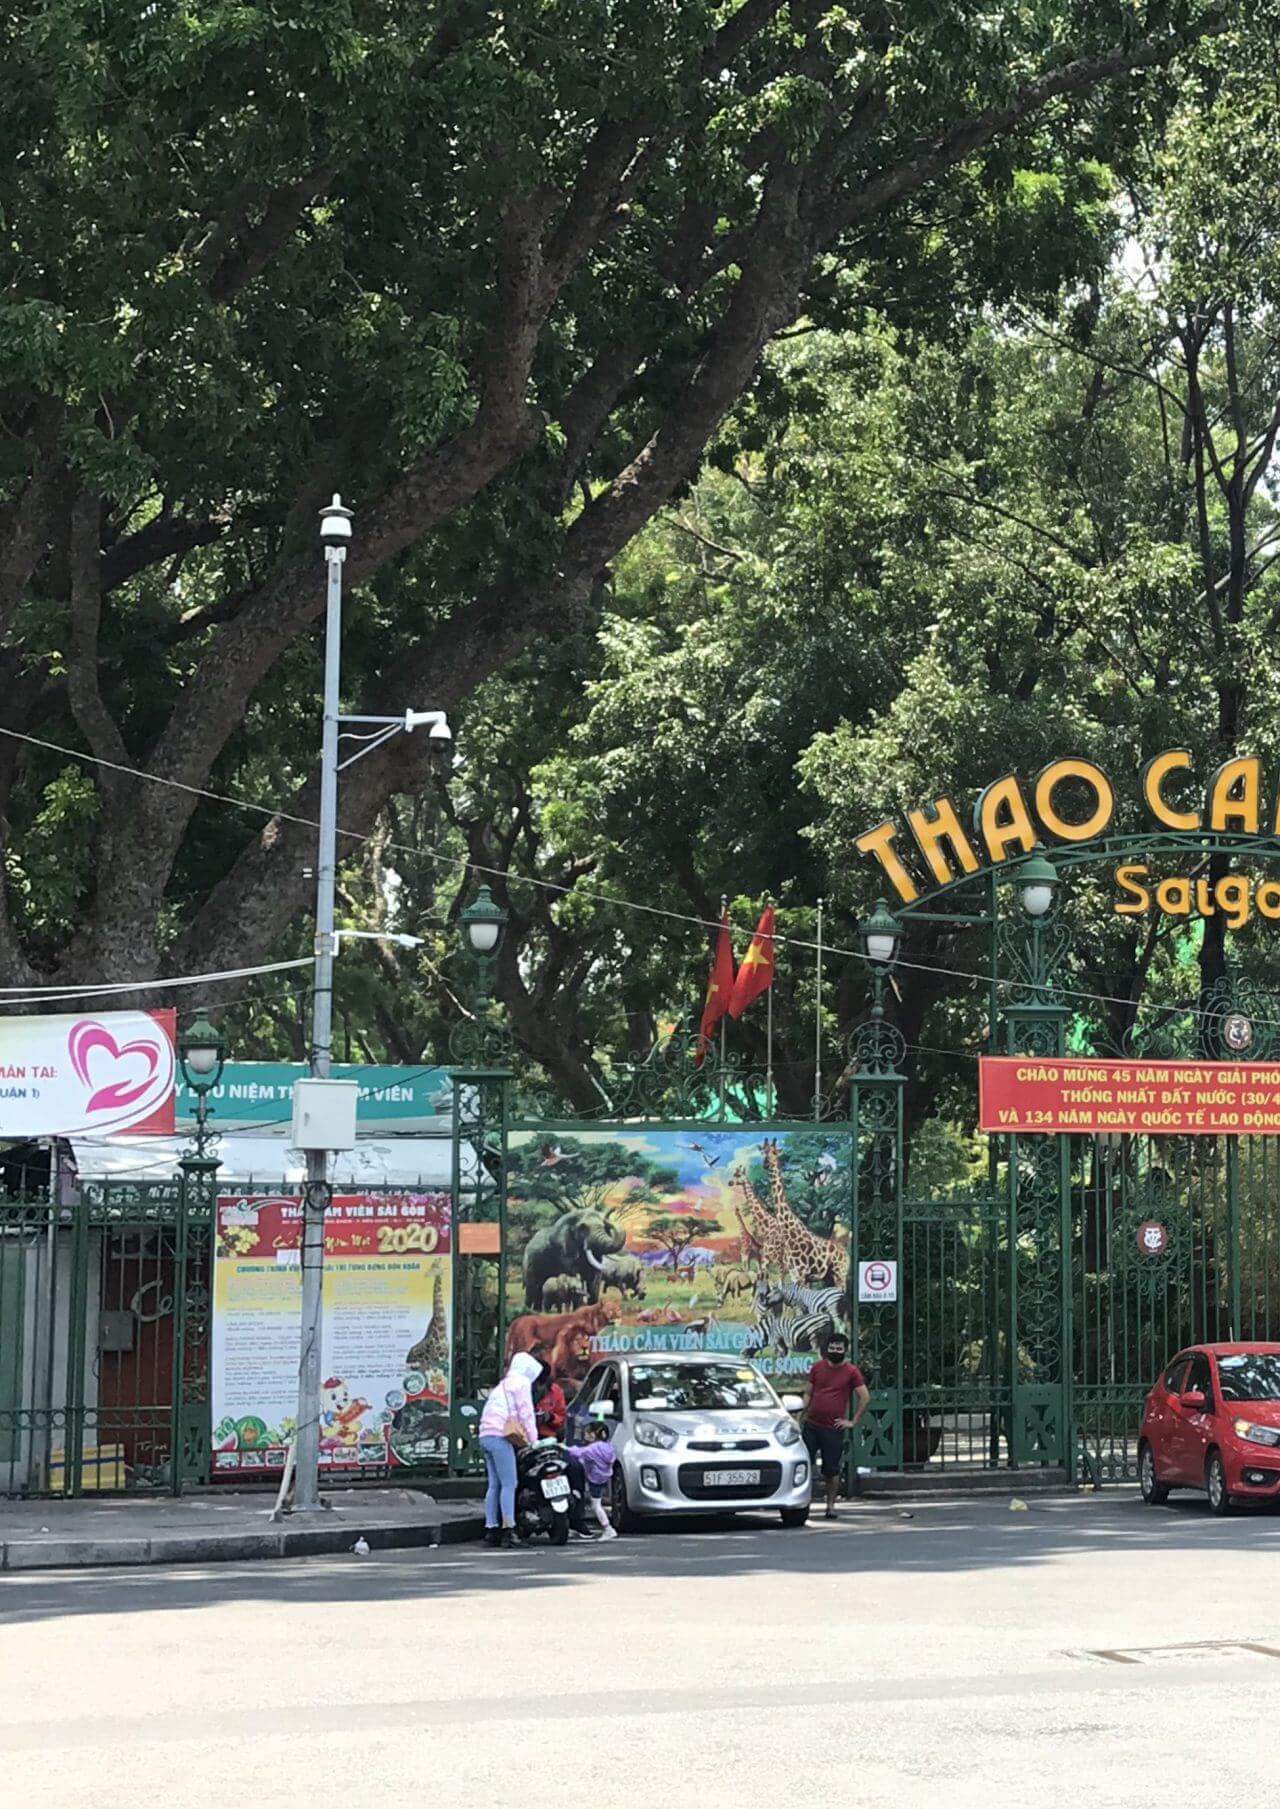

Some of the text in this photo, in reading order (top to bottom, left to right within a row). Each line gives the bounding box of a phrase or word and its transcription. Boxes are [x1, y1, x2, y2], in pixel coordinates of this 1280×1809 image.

[853, 756, 1114, 905] THAO
[1016, 1066, 1059, 1082] CHÀO
[1063, 1066, 1107, 1082] MỪNG
[1112, 1070, 1131, 1082] 45
[1135, 1068, 1169, 1083] NĂM
[1174, 1068, 1213, 1084] NGÀY
[1217, 1067, 1247, 1084] GIẢI
[0, 1086, 26, 1101] UẬN
[229, 1082, 274, 1104] NIỆM
[373, 1085, 413, 1101] VIÊN
[1060, 1086, 1112, 1103] THỐNG
[1117, 1086, 1156, 1104] NHẤT
[1161, 1087, 1191, 1104] ĐẤT
[1196, 1089, 1236, 1104] NƯỚC
[998, 1107, 1019, 1123] VÀ
[1025, 1110, 1053, 1124] 134
[1058, 1109, 1092, 1124] NĂM
[1097, 1108, 1136, 1124] NGÀY
[1141, 1108, 1182, 1126] QUỐC
[1185, 1108, 1207, 1125] TẾ
[1210, 1112, 1239, 1125] LAO
[376, 1222, 439, 1253] 2020
[589, 1330, 631, 1353] THẢO
[669, 1328, 704, 1351] VIÊN
